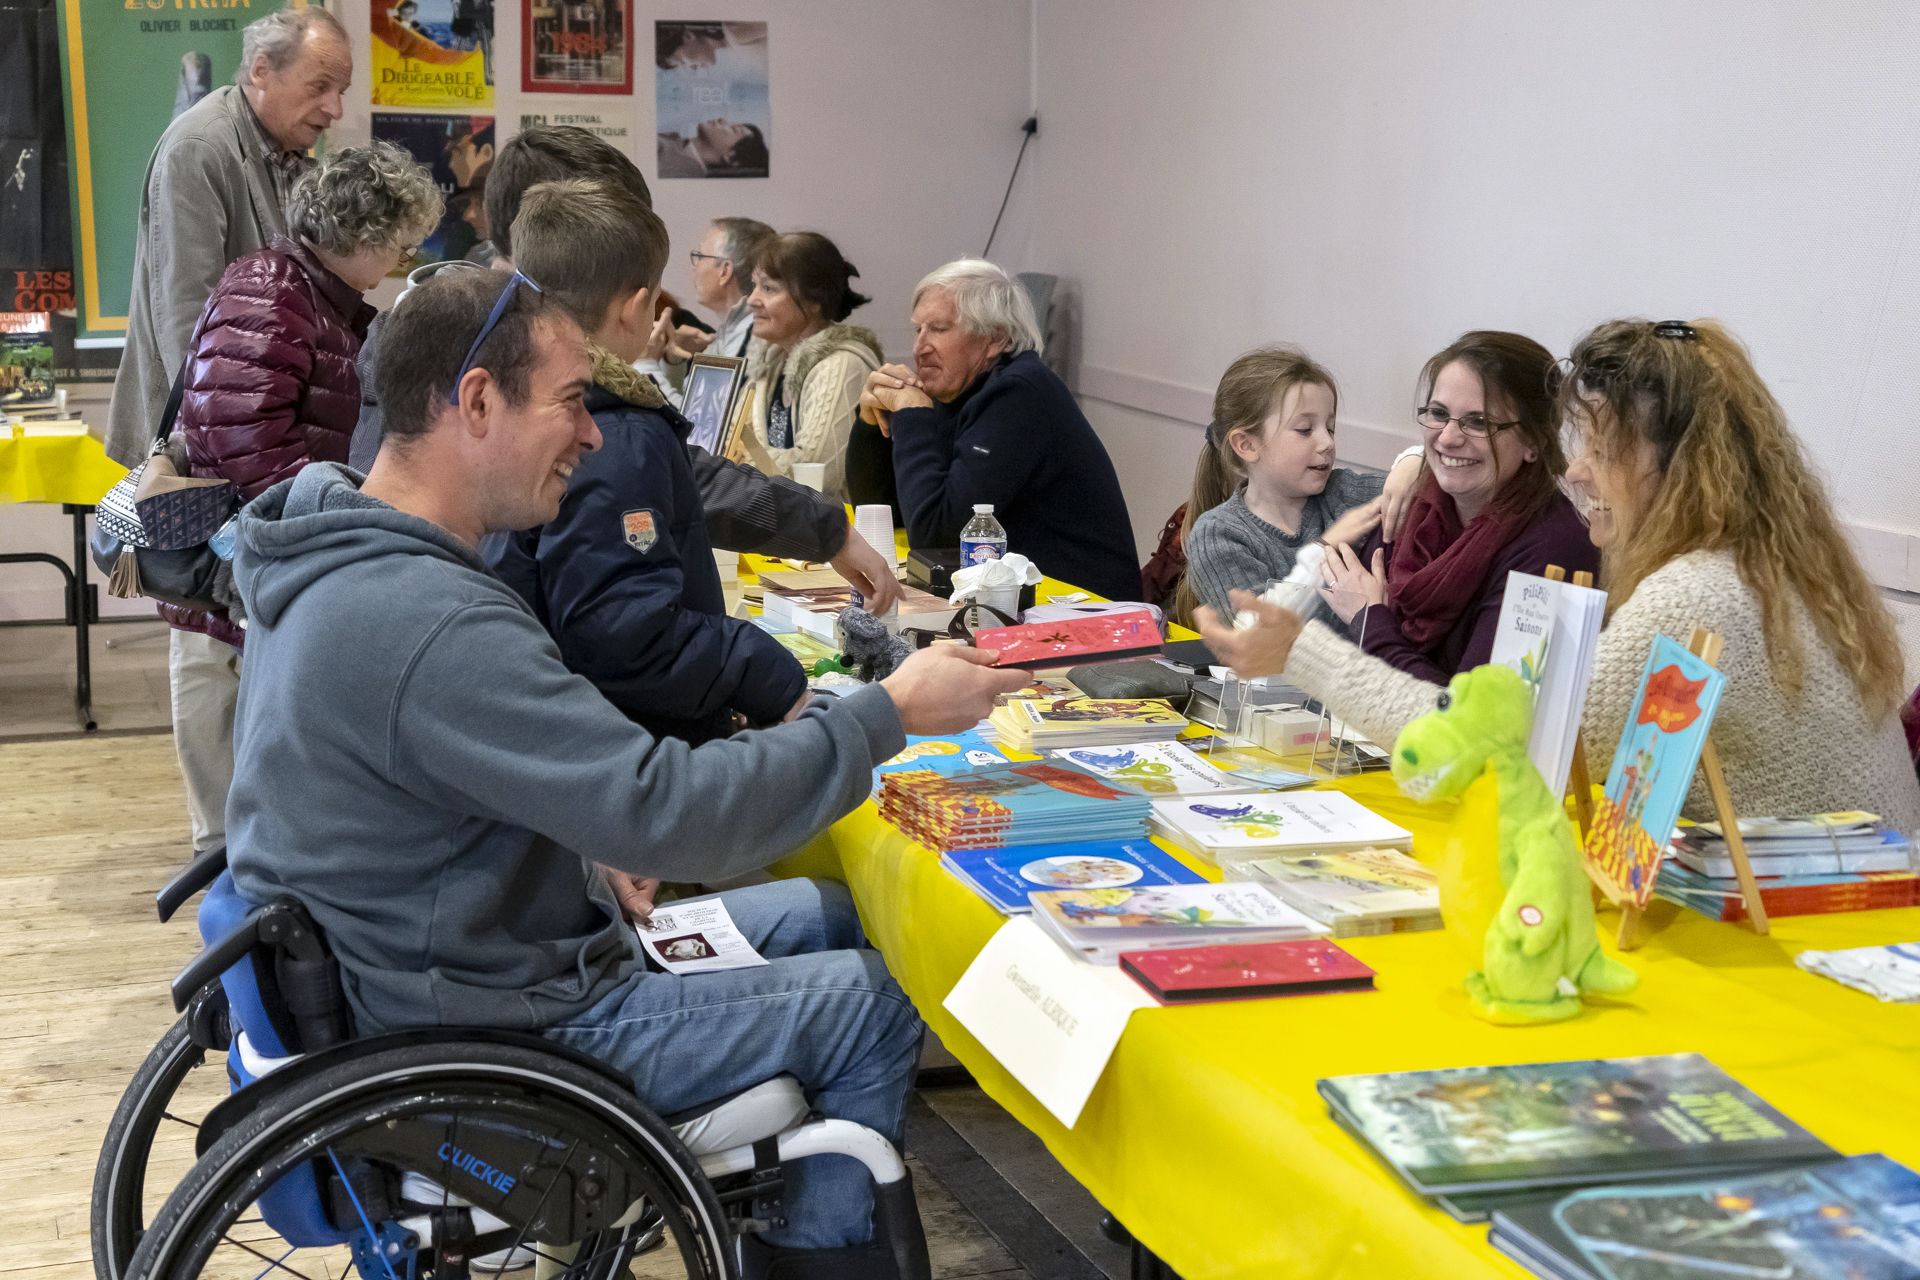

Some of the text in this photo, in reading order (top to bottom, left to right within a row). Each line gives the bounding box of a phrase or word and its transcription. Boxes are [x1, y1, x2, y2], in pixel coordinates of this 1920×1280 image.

[140, 18, 236, 32] OLIVIER BLOCHET
[382, 67, 475, 85] DIRIGEABLE
[445, 82, 485, 100] VOLÉ
[554, 114, 603, 124] FESTIVAL
[15, 271, 71, 290] LES
[438, 1142, 517, 1195] QUICKIE
